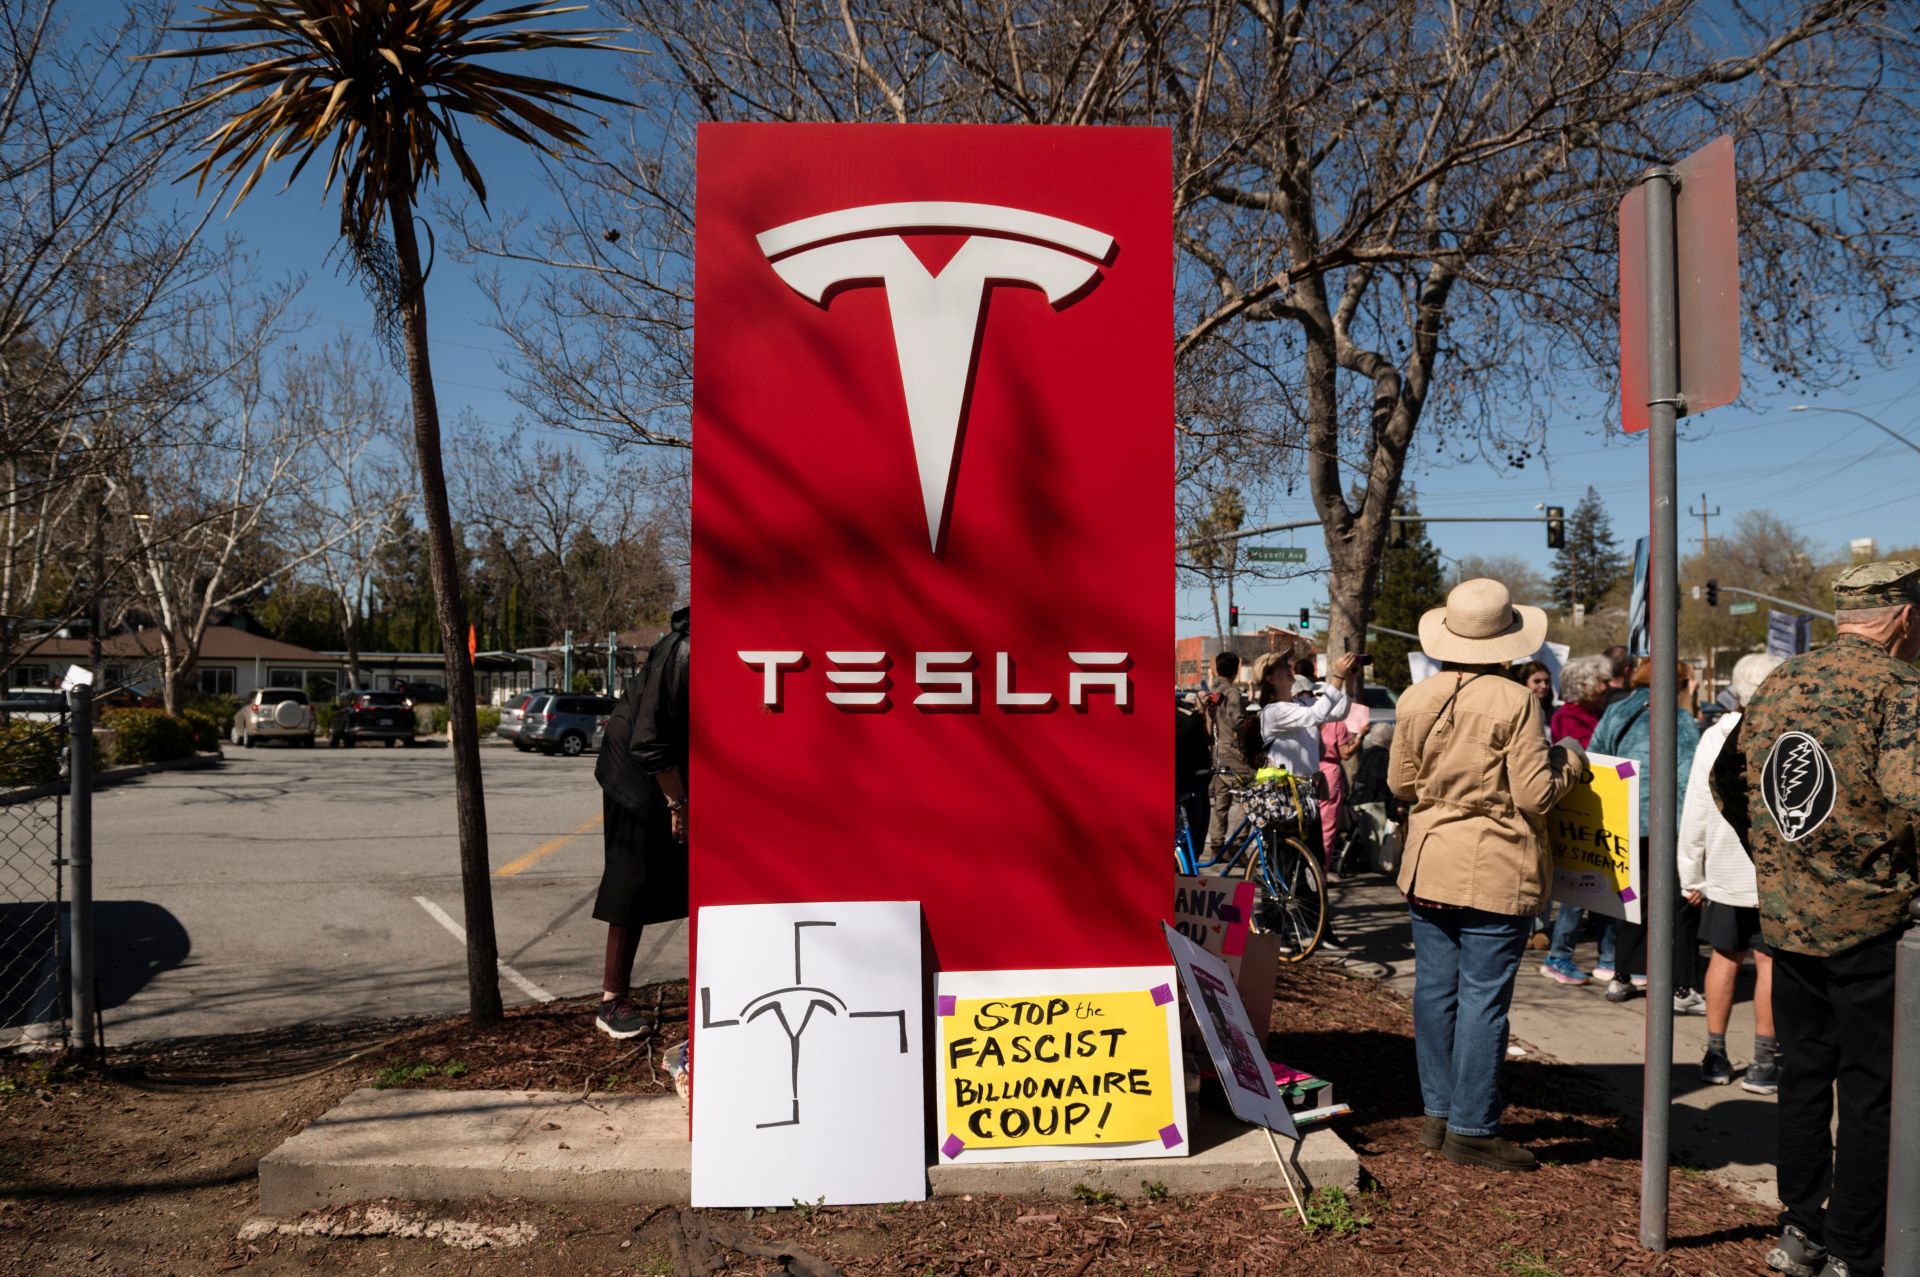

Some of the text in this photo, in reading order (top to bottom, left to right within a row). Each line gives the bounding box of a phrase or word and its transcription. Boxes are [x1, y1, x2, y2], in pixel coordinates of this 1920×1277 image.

[737, 650, 1128, 705] TESLA
[1175, 888, 1226, 919] ANK
[974, 998, 1106, 1031] STOP the
[949, 1028, 1127, 1069] FASCIST
[954, 1068, 1152, 1107] BILLIONAIRE
[968, 1101, 1113, 1139] COUP!
